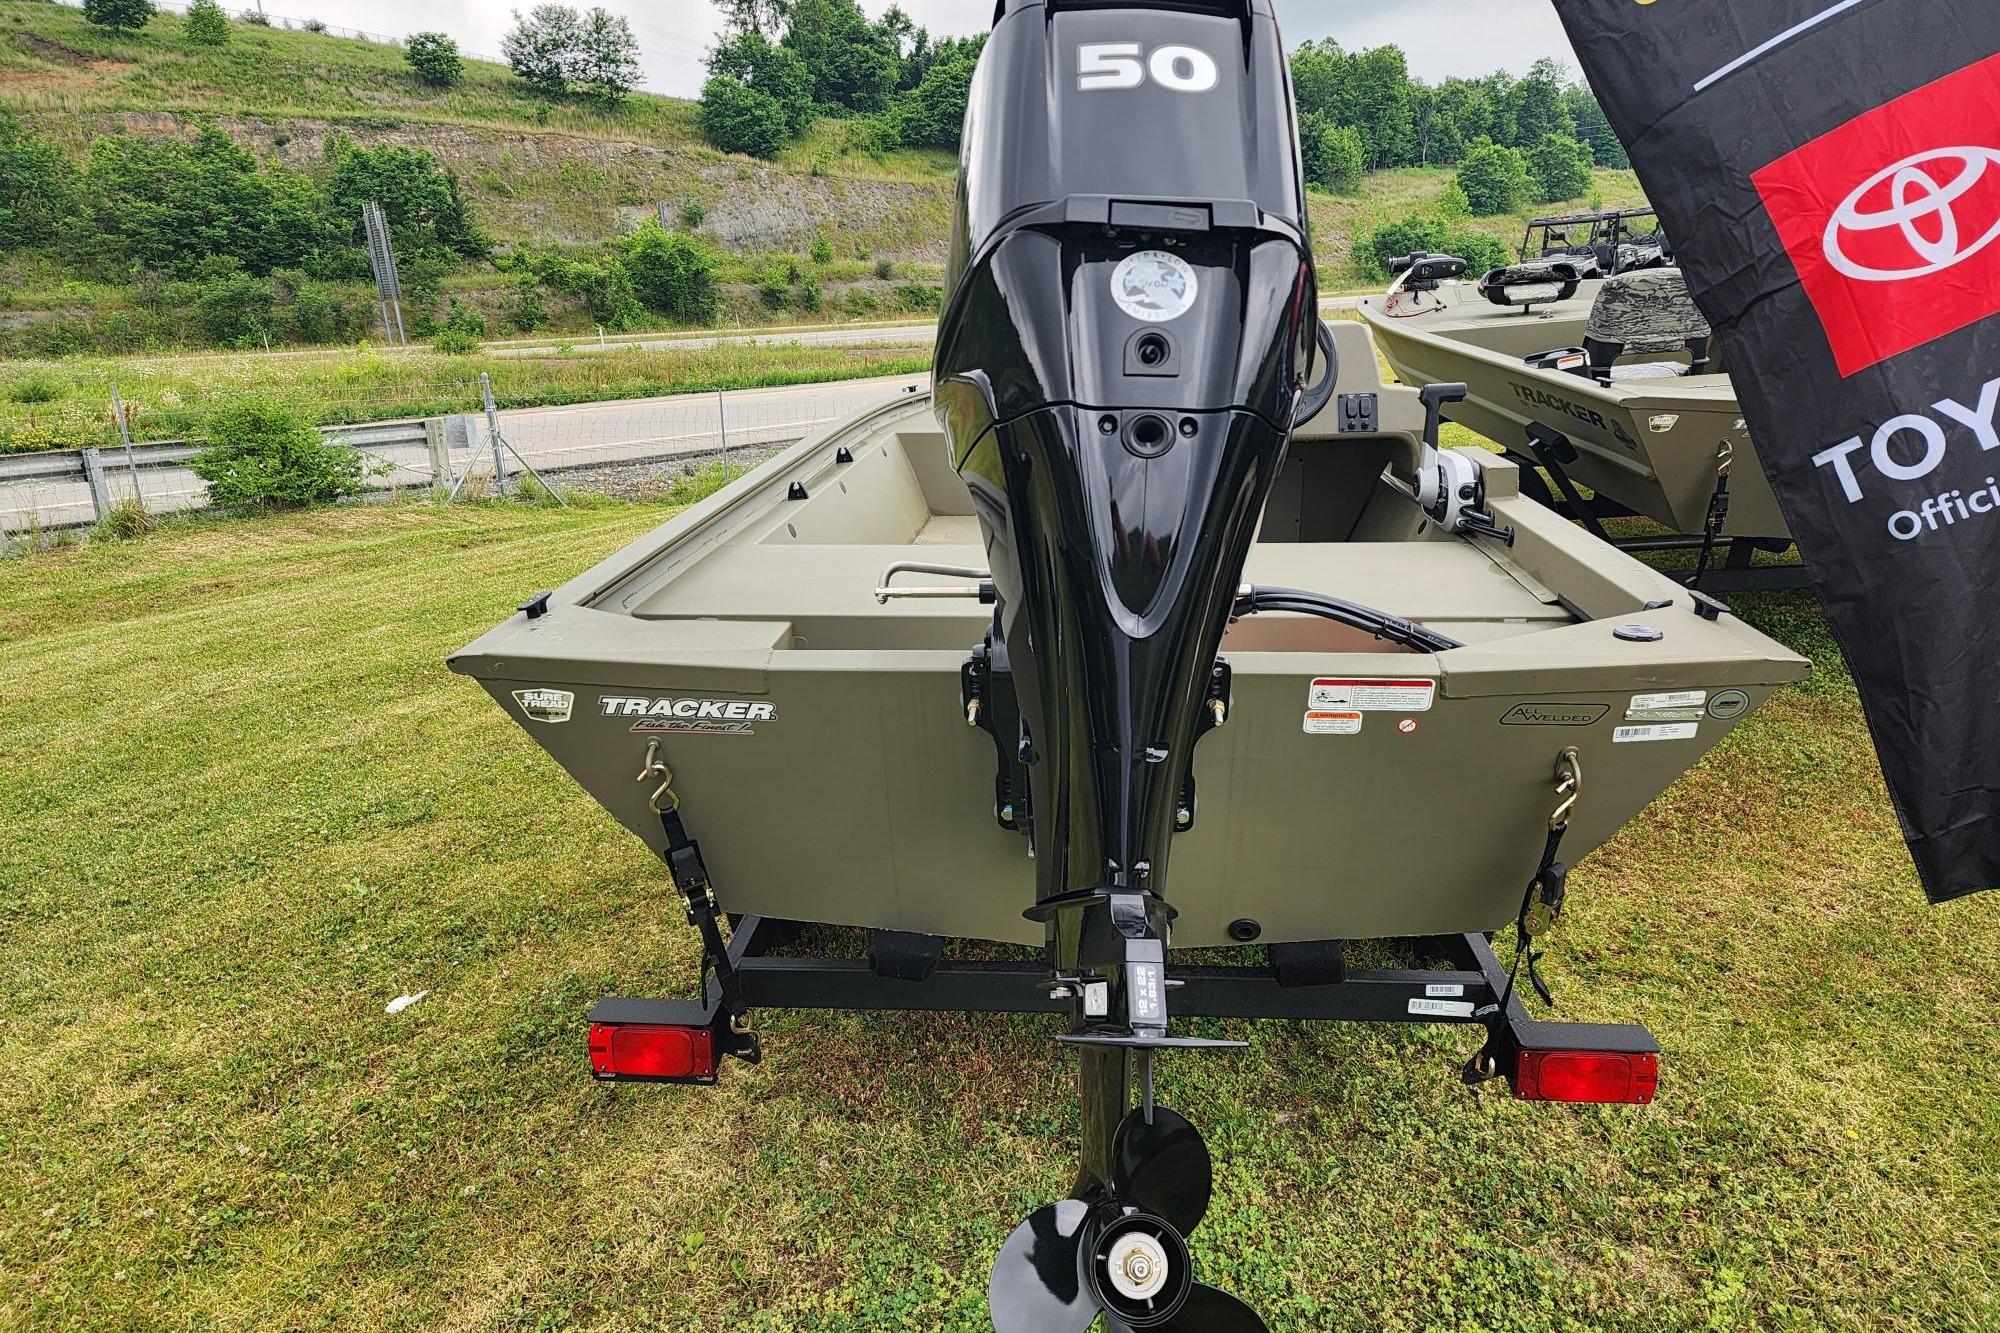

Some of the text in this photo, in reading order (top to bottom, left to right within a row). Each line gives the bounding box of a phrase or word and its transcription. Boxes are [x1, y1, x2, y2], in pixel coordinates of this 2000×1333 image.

[1079, 43, 1217, 92] 50
[1508, 381, 1608, 431] TRACKER
[524, 692, 562, 701] SURE
[522, 700, 568, 708] TREAD
[601, 697, 773, 720] TRACKER
[1512, 708, 1542, 717] ALL
[1523, 713, 1594, 722] WELDED
